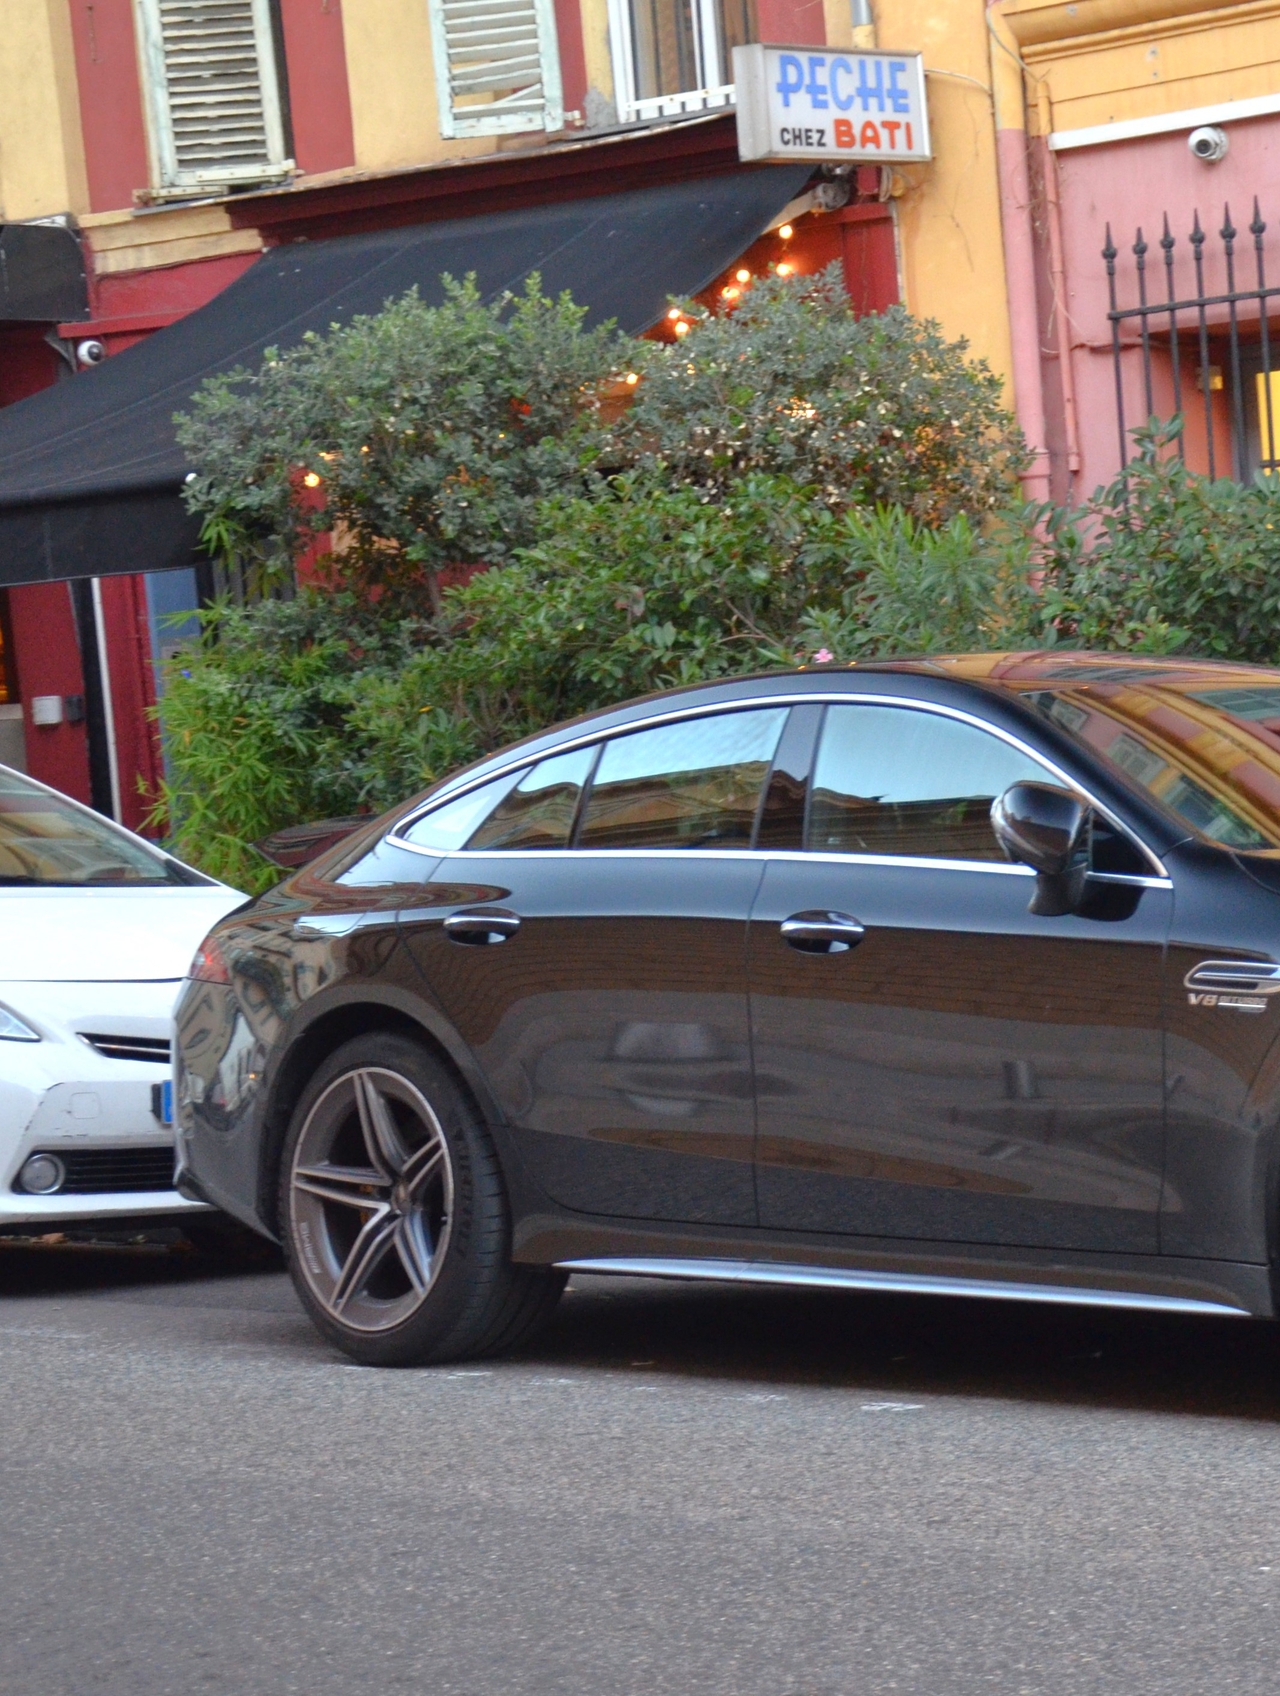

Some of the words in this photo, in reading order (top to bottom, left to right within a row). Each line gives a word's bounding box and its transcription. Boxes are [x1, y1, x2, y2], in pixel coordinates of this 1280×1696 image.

[776, 54, 910, 113] PECHE
[780, 127, 827, 147] CHEZ
[833, 118, 914, 150] BATI
[1187, 993, 1218, 1006] V8
